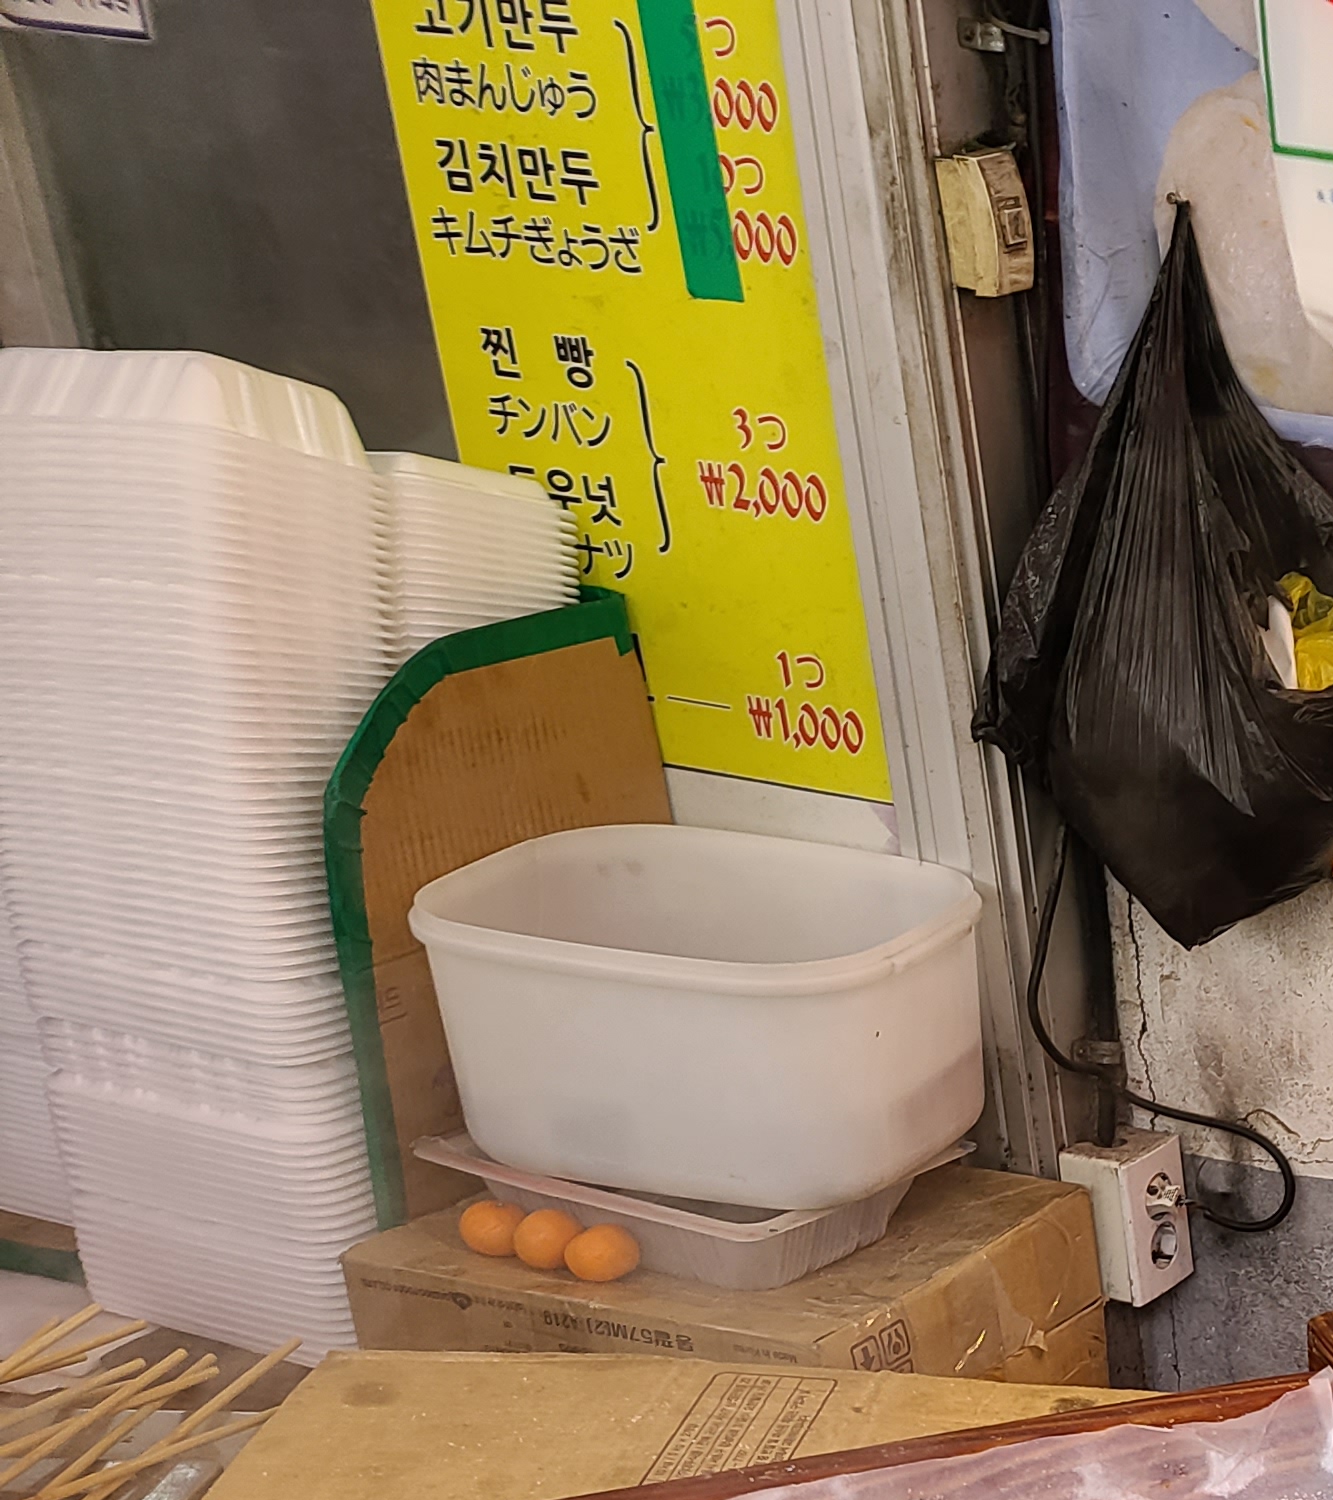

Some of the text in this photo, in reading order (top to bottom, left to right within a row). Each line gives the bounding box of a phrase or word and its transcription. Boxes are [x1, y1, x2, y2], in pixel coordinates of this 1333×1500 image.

[412, 59, 596, 118] 肉まんじゅう
[436, 139, 599, 205] 김치만두
[431, 207, 642, 273] キムチぎょうざ
[732, 407, 787, 450] 3つ
[509, 465, 622, 526] 우넛
[699, 460, 827, 522] ₩2,000
[776, 651, 824, 688] 1つ
[747, 694, 864, 754] ₩1,000
